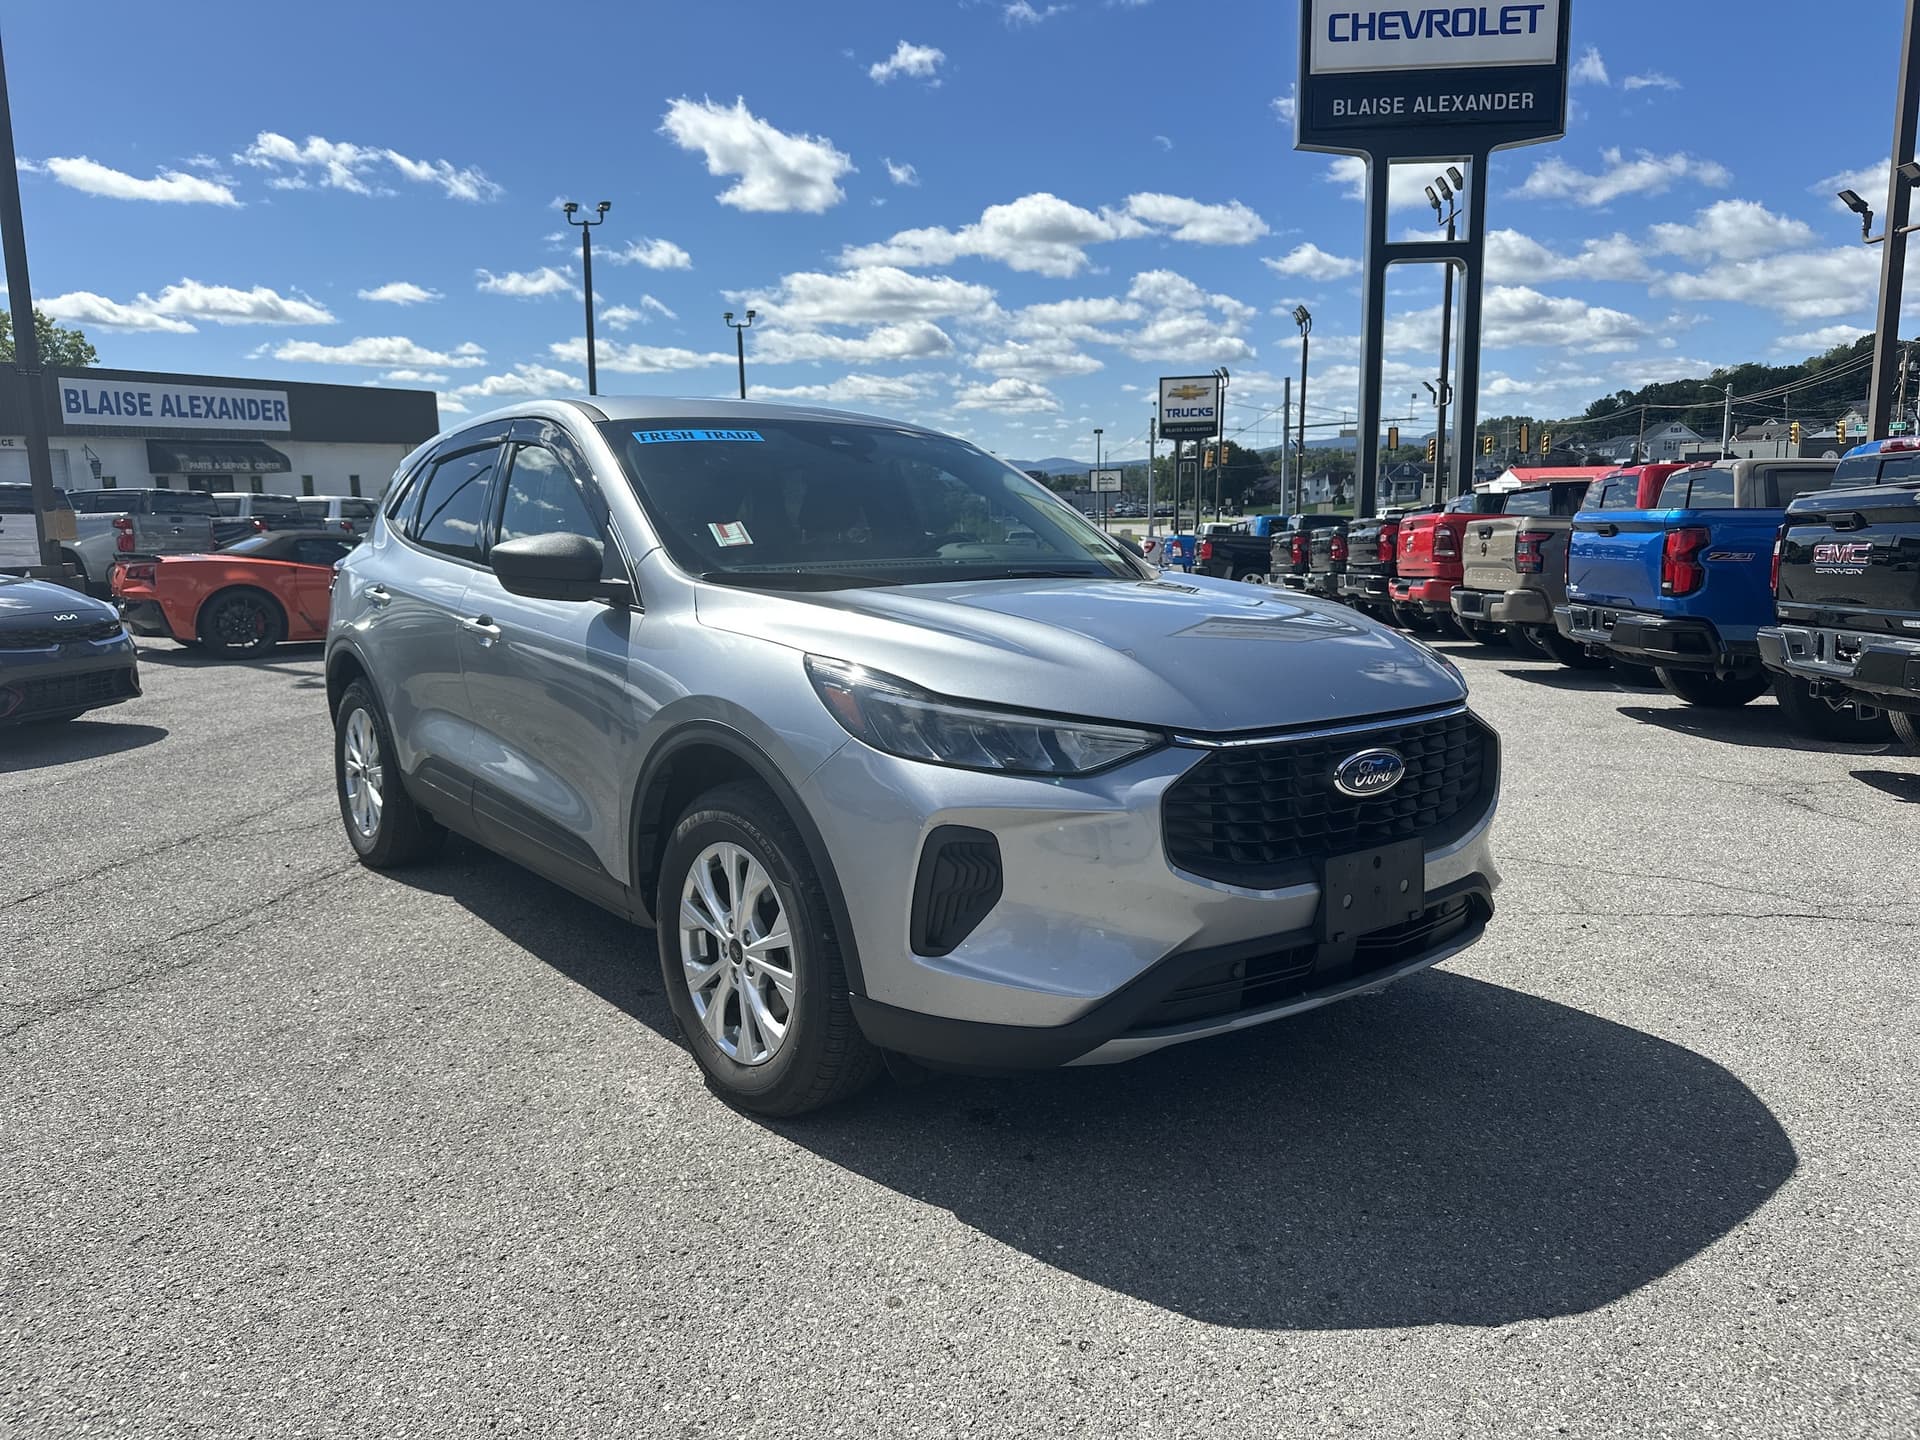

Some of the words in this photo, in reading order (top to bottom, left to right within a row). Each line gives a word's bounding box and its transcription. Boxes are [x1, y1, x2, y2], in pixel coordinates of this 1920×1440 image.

[1328, 4, 1545, 42] CHEVROLET
[1333, 97, 1405, 116] BLAISE
[1413, 92, 1534, 113] ALEXANDER
[64, 388, 153, 417] BLAISE
[160, 394, 288, 422] ALEXANDER
[1165, 407, 1214, 418] TRUCKS
[0, 439, 14, 447] CE
[639, 431, 695, 442] FRESH
[703, 430, 760, 441] TRADE
[1814, 543, 1873, 564] GMC
[1815, 567, 1864, 575] CANYON
[1354, 758, 1393, 787] Ford
